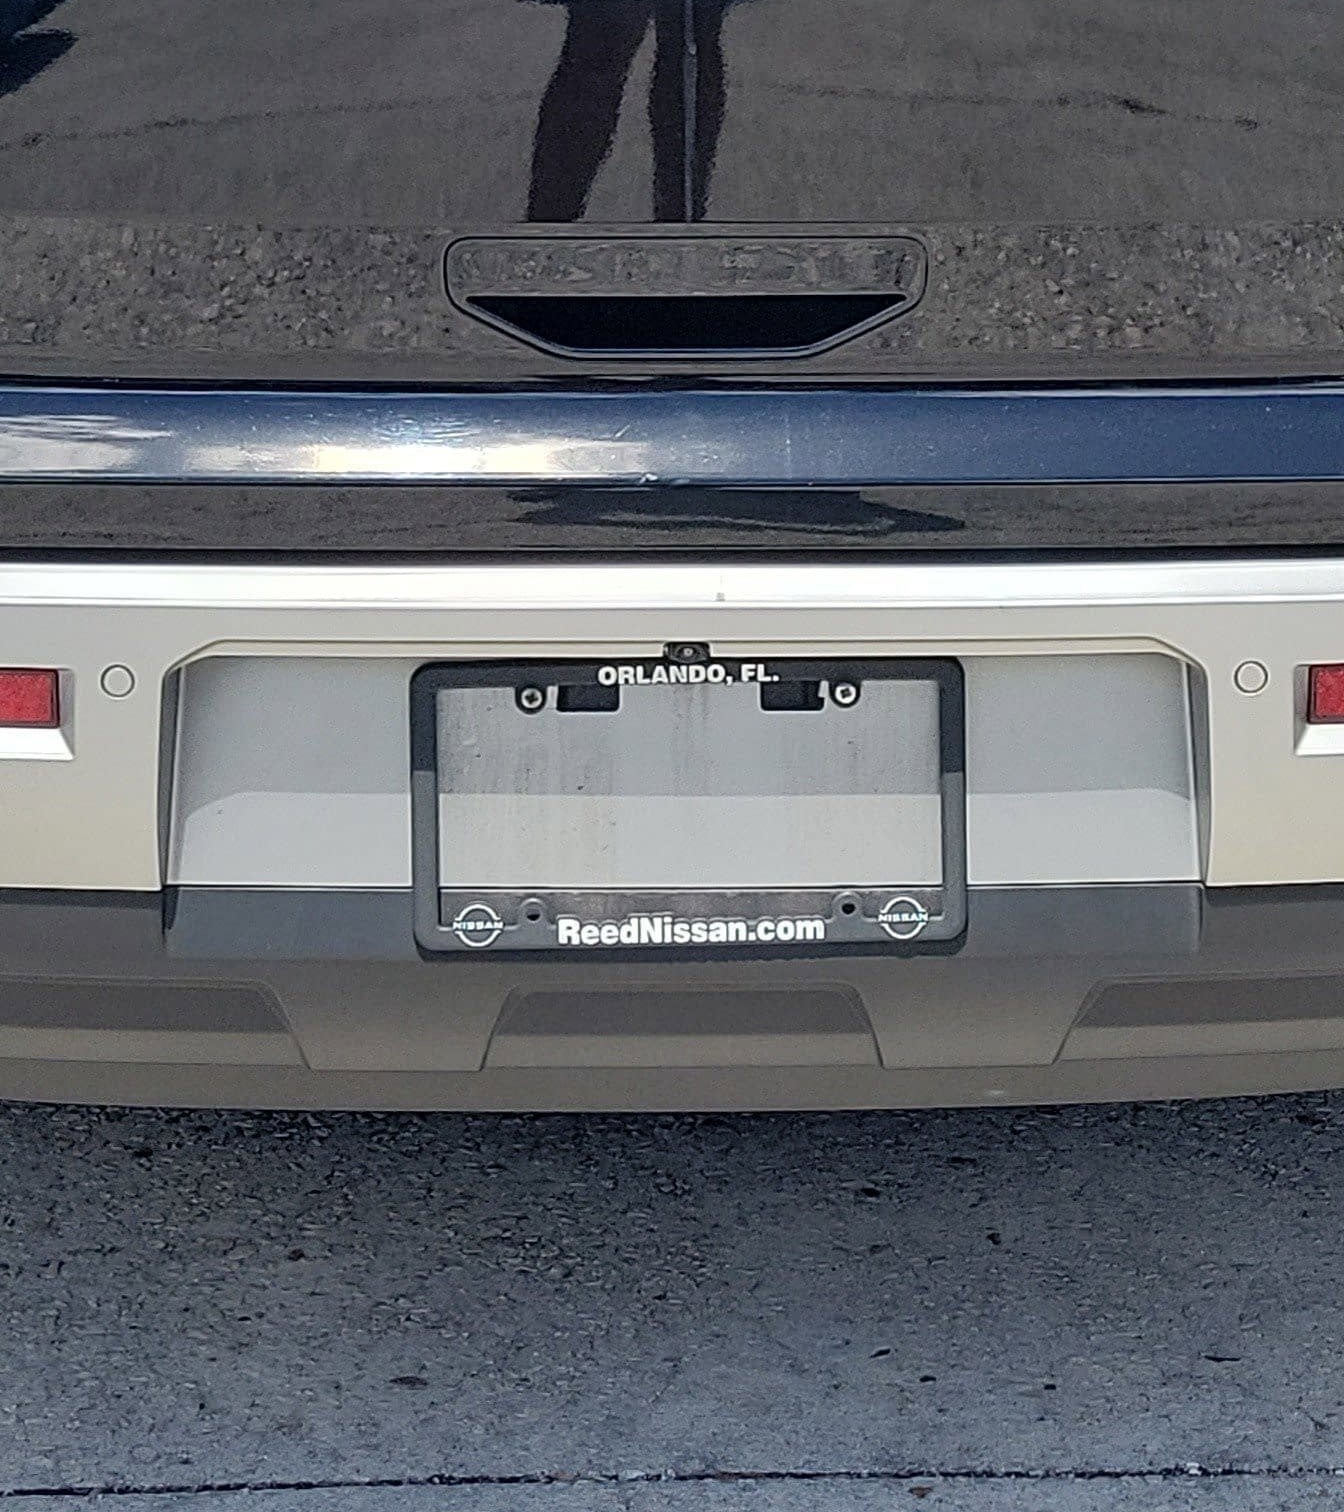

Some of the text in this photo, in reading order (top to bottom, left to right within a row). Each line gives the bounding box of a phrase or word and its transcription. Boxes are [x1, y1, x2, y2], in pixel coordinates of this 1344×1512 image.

[597, 663, 780, 686] ORLANDO, FL.
[452, 921, 504, 931] NISSAN
[556, 916, 825, 946] ReedNissan.com
